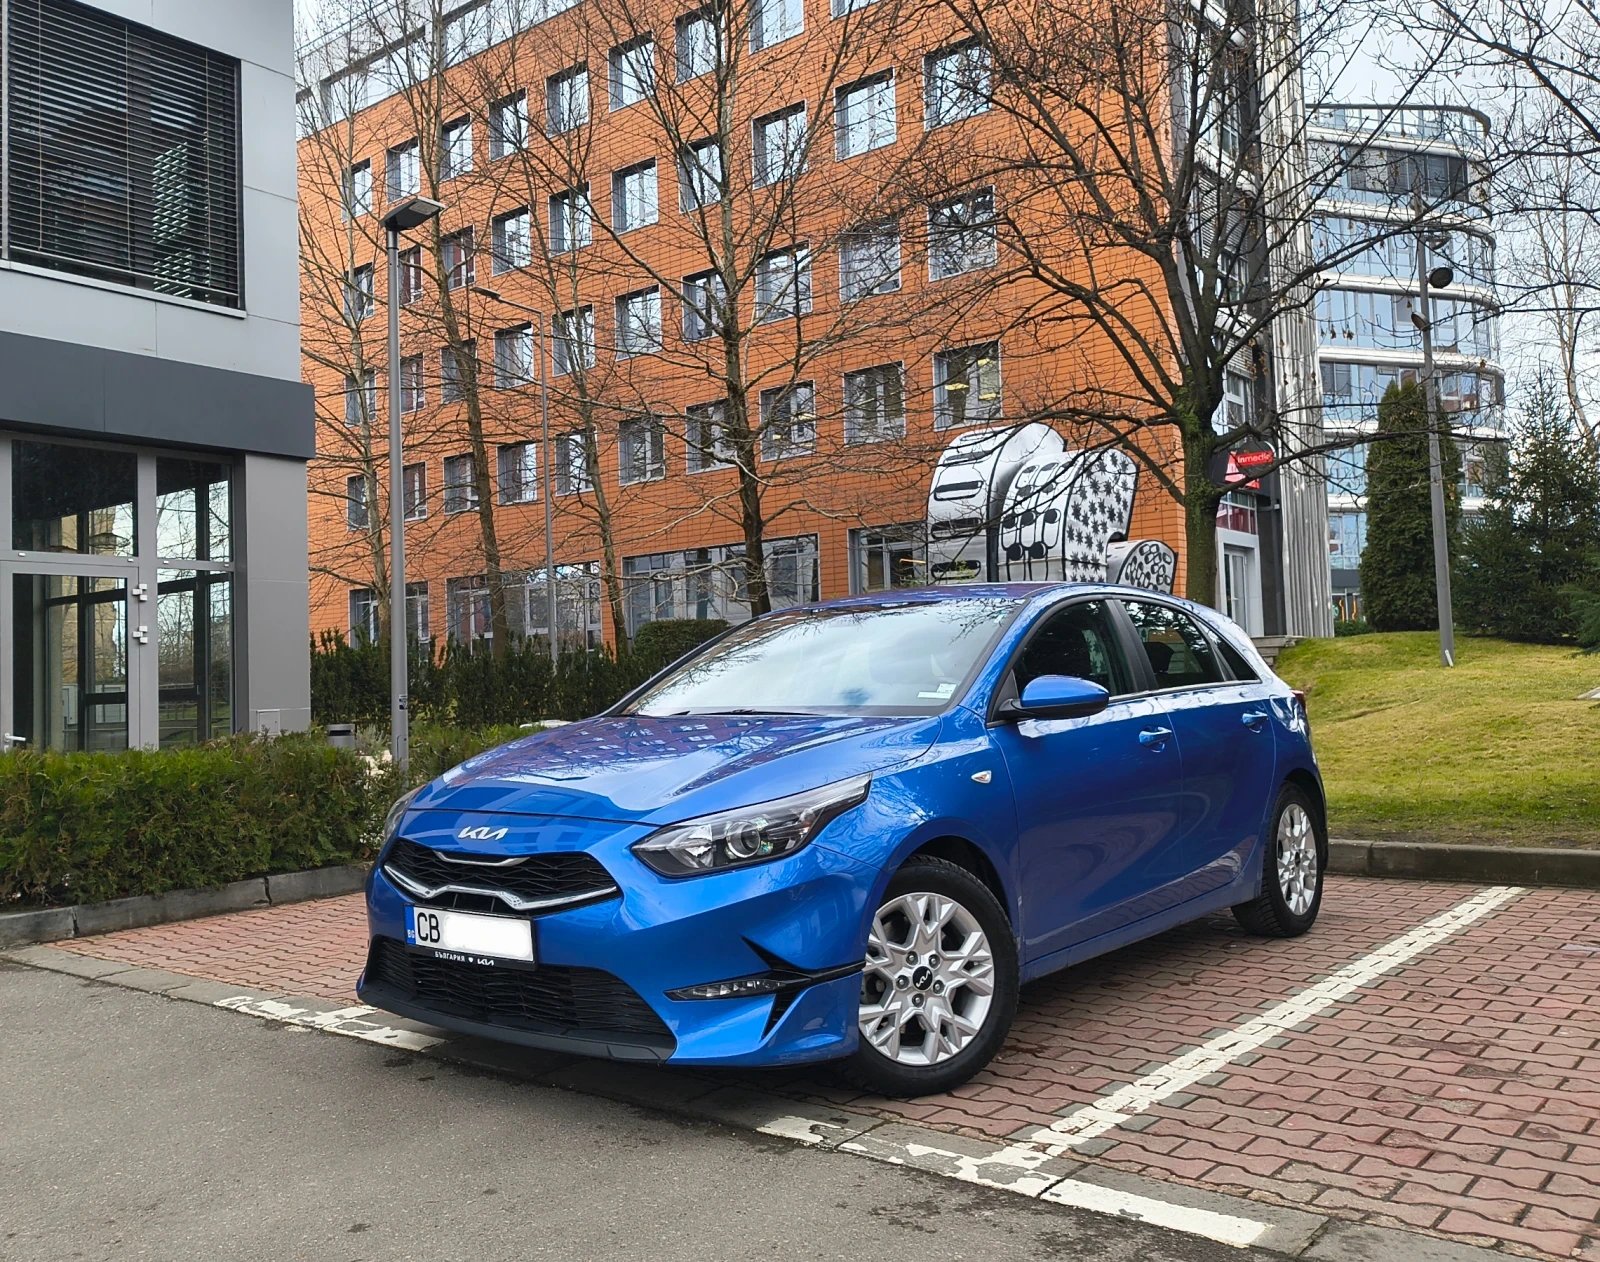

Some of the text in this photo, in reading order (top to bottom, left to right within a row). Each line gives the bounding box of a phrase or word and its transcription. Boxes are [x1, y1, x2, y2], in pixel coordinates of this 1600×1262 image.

[458, 826, 509, 841] KIA
[407, 929, 415, 939] BG
[434, 951, 495, 966] БЪЛГАРИЯ KIA
